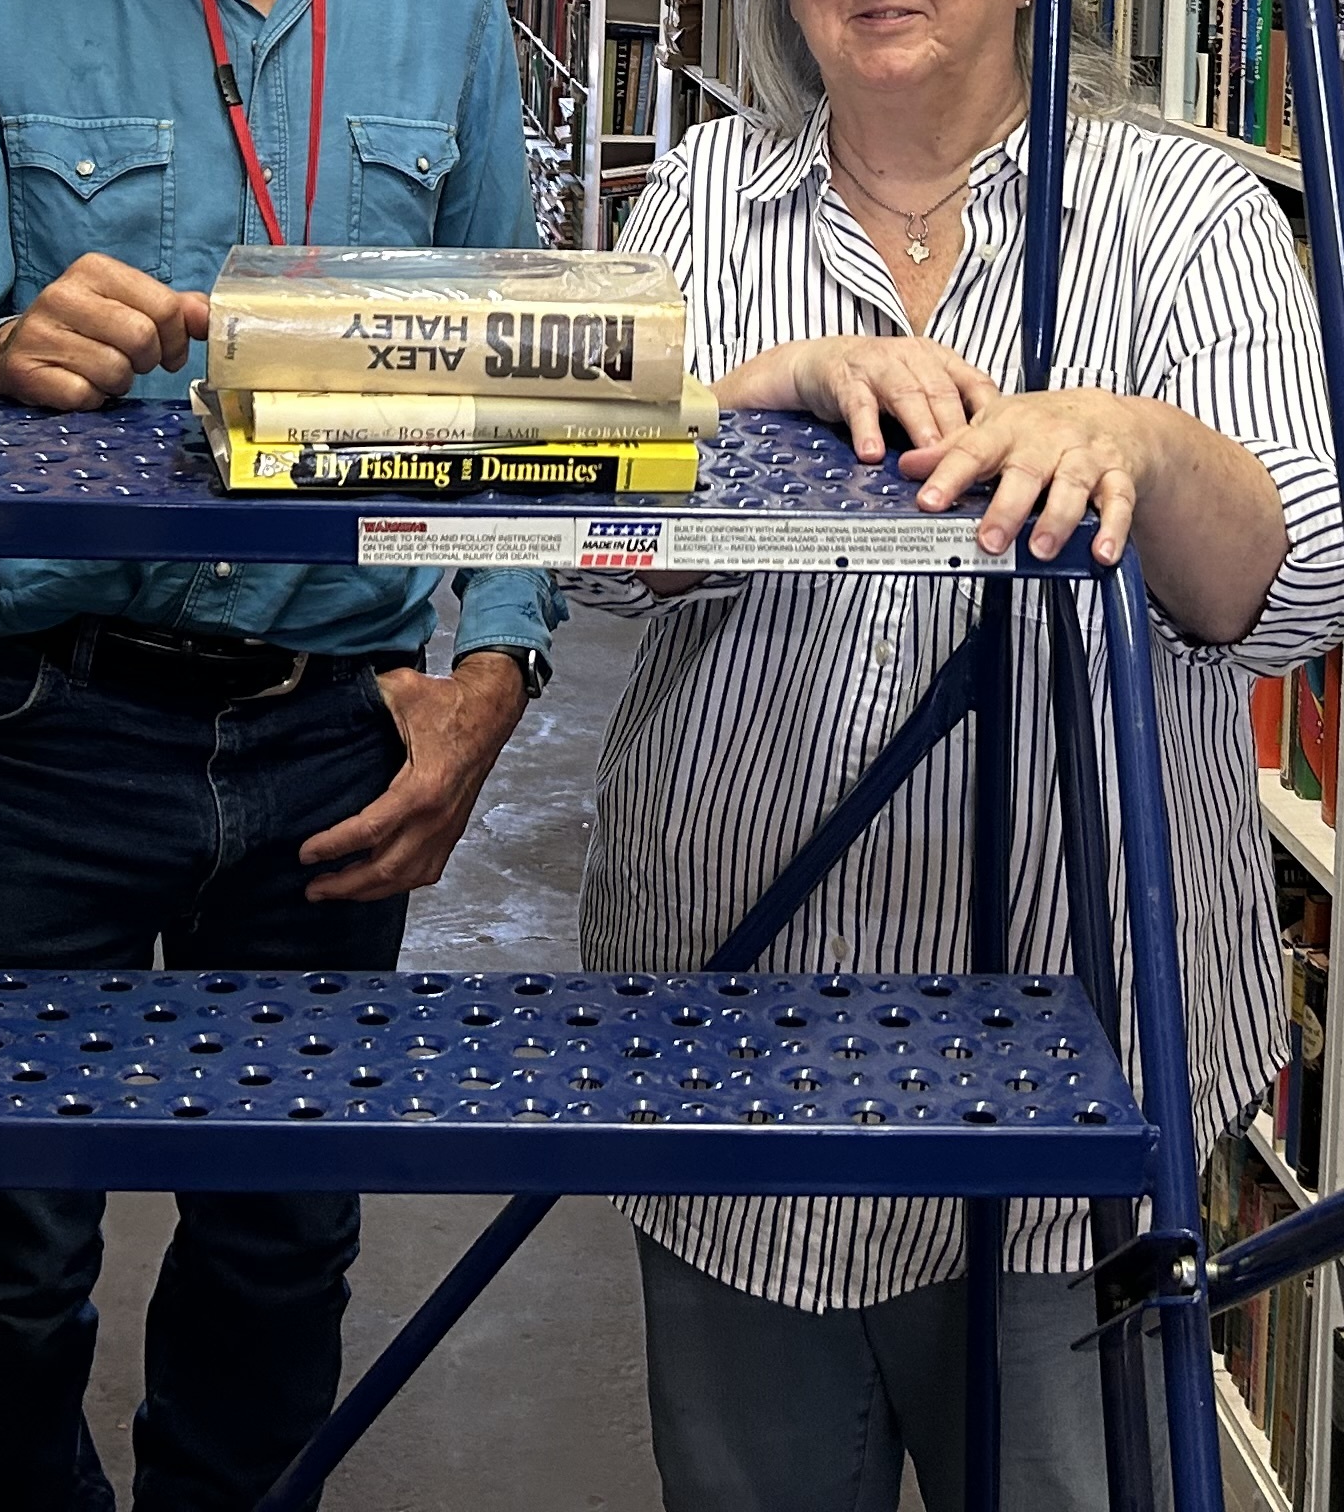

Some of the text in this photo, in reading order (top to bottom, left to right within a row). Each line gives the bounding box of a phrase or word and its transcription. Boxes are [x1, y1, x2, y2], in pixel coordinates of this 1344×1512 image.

[341, 313, 469, 341] HALEY
[484, 310, 636, 382] ROOTS
[366, 344, 466, 371] ALEX
[287, 423, 661, 443] RESTING BOSOM LAMB TROBAUGH
[313, 453, 594, 486] Fly Fishing Dummies
[364, 521, 428, 533] WARNING
[705, 525, 965, 535] CONFORMITY AMERICAN NATIONAL STANDARDS INSTITUTE SAFETY
[363, 534, 562, 544] FAILURE TO READ AND FOLLOW INSTRUCTIONS
[582, 538, 658, 553] MADE IN USA
[711, 535, 818, 543] ELECTRICAL HAZARD
[363, 543, 561, 553] ON THE USE OF THIS PRODUCT COULD RESULT
[373, 553, 413, 561] SERIOUS
[414, 553, 460, 562] PERSONAL
[463, 553, 494, 562] INJURY
[495, 553, 510, 562] OR
